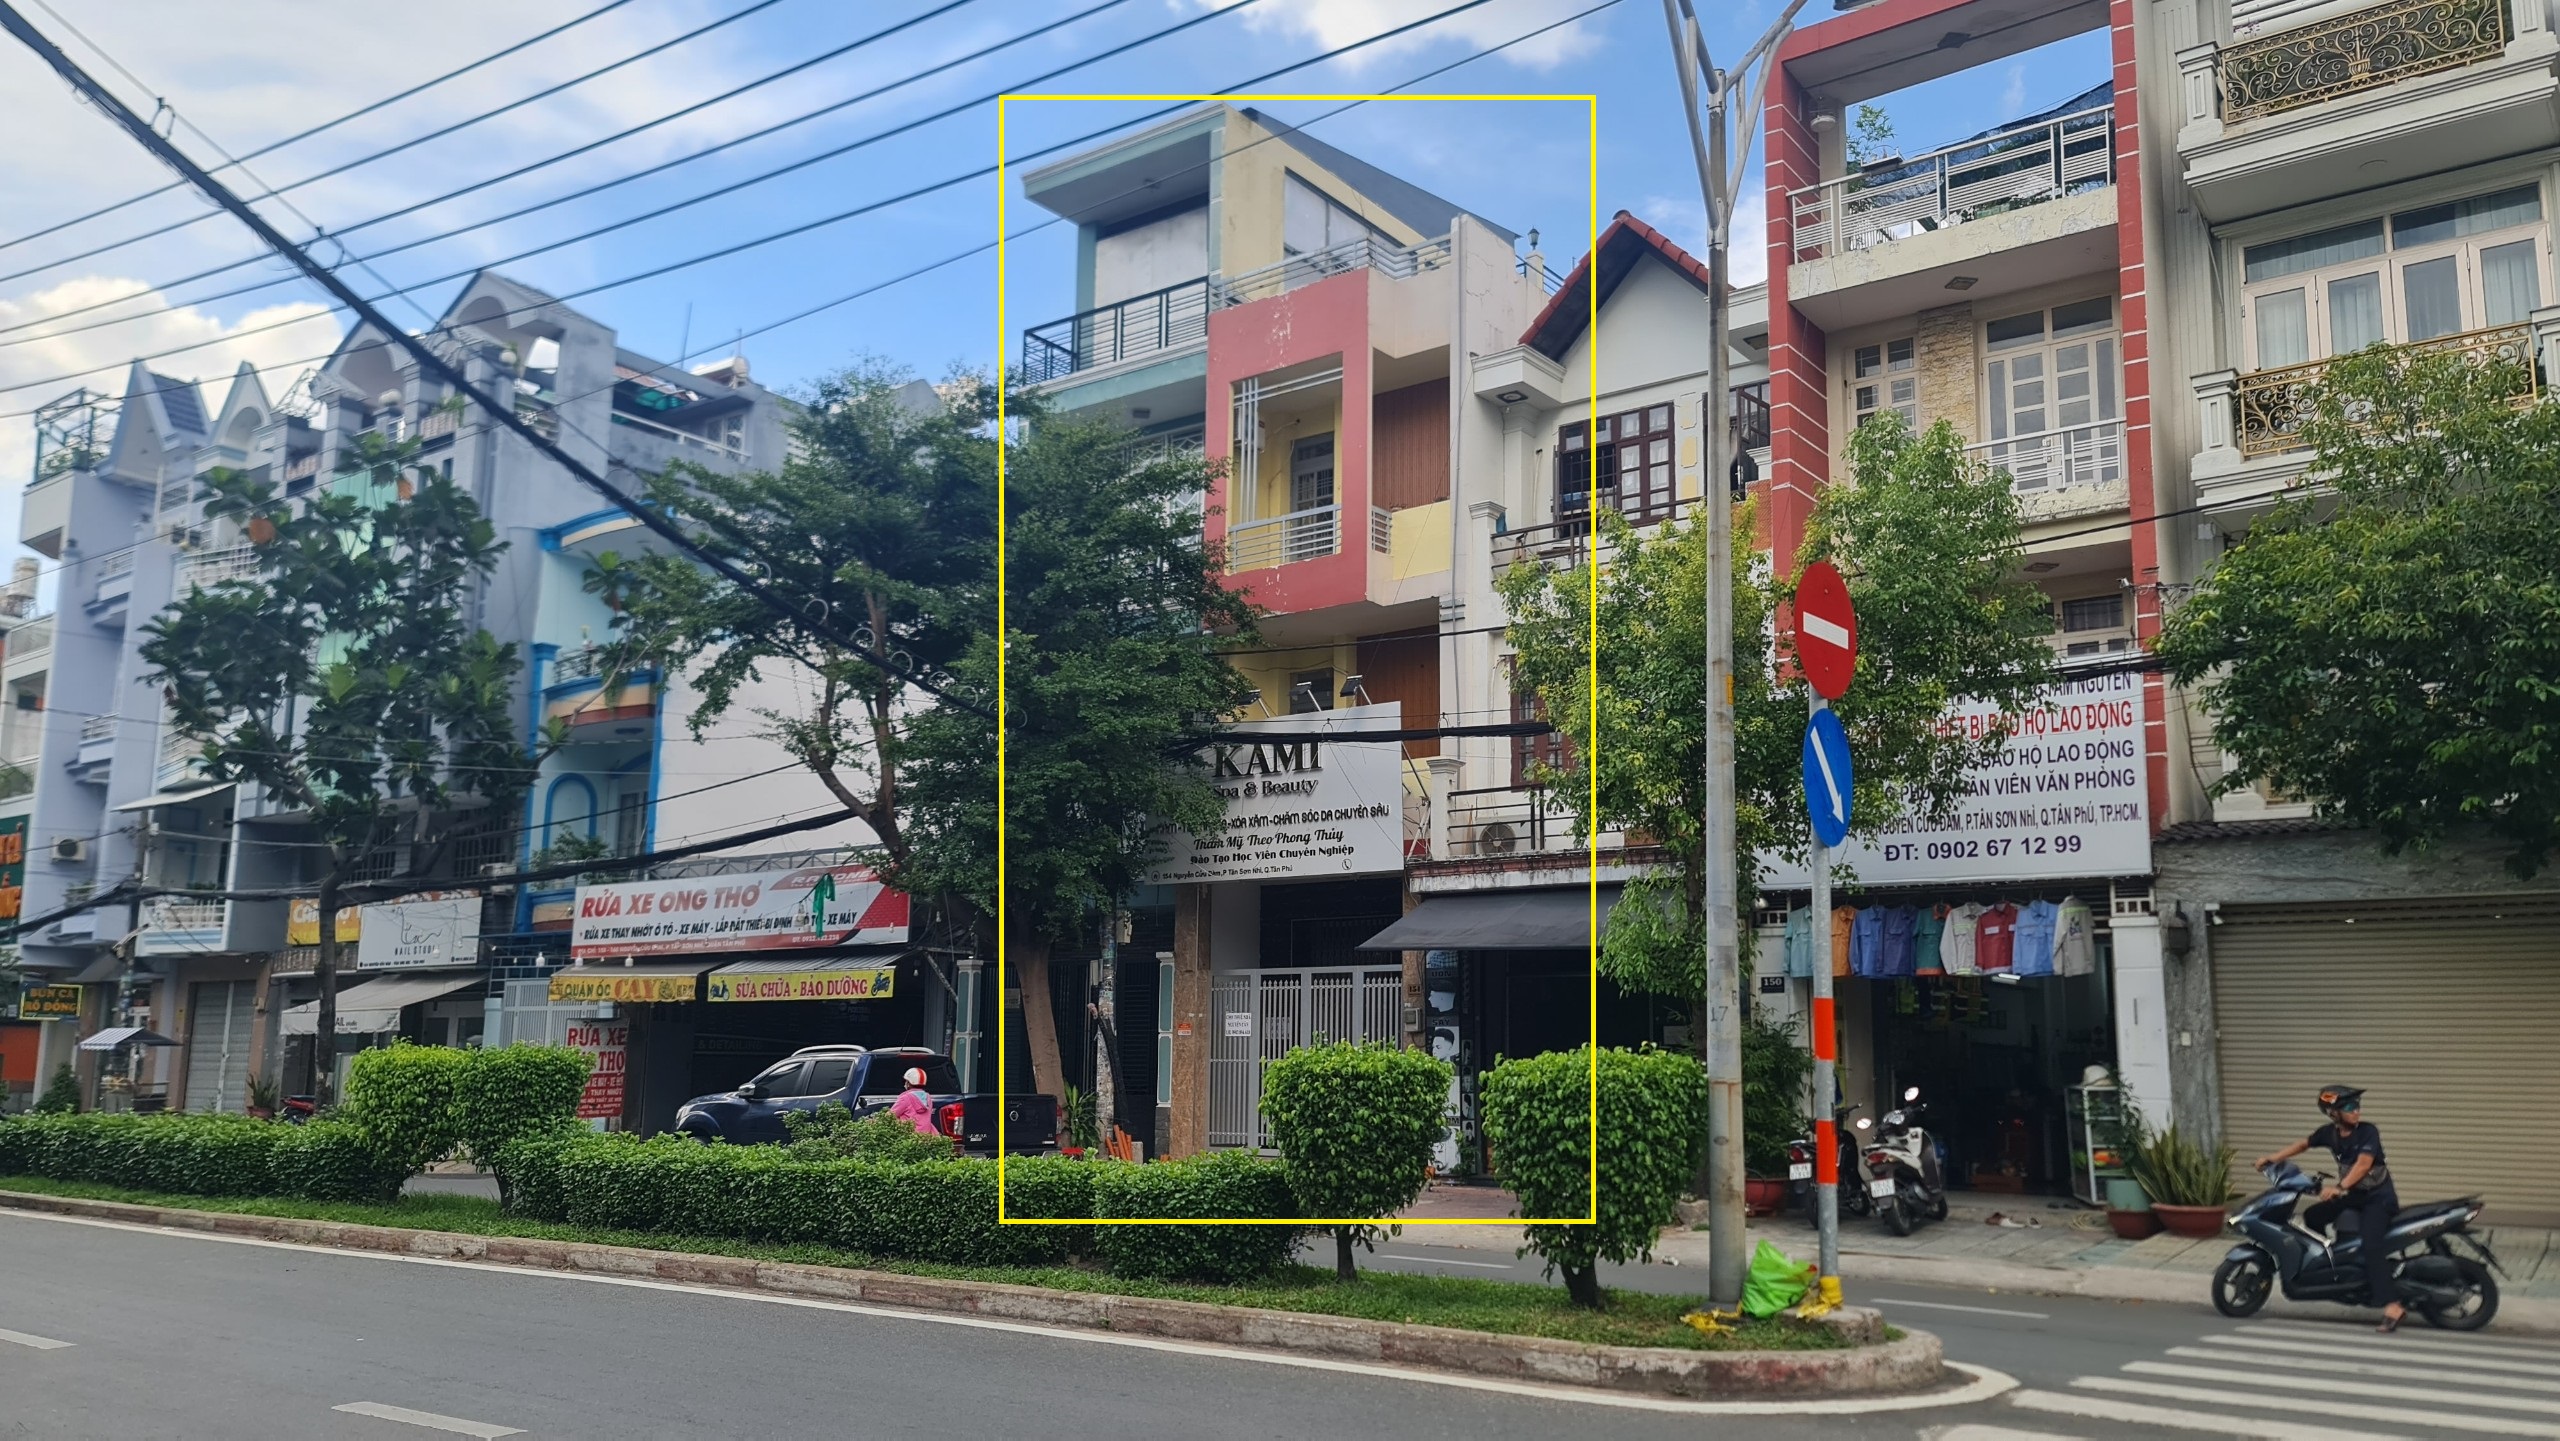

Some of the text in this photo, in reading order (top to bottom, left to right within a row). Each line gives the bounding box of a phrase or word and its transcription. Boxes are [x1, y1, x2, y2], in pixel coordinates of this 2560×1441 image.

[2025, 707, 2047, 740] HỘ
[2052, 705, 2082, 732] LAO
[2086, 699, 2133, 735] ĐỘNG
[1213, 741, 1323, 777] KAMI
[2020, 742, 2042, 765] HỘ
[2047, 744, 2081, 764] LAO
[2085, 739, 2135, 763] ĐỘNG
[1243, 782, 1257, 797] &
[1262, 779, 1319, 796] Beauty
[1994, 773, 2031, 795] VIÊN
[2035, 770, 2070, 792] VĂN
[2075, 767, 2136, 790] PHÒNG
[1302, 808, 1319, 824] SÓC
[1321, 809, 1333, 822] DA
[1335, 806, 1369, 821] CHUYÊN
[1370, 803, 1390, 818] SÂU
[1966, 811, 1993, 831] P.TÂN
[1996, 809, 2017, 829] SƠN
[2041, 806, 2072, 828] Q.TÂN
[1226, 835, 1244, 850] Mỹ
[1247, 832, 1273, 847] Theo
[1274, 831, 1311, 848] Phong
[1314, 827, 1344, 842] Thủy
[1884, 835, 2082, 861] ĐT: 0902 67 12 99
[1212, 854, 1230, 865] Tạo
[1232, 851, 1252, 863] Học
[1255, 848, 1276, 860] Viên
[1279, 847, 1316, 861] Chuyên
[1319, 844, 1354, 859] Nghiệp
[792, 870, 872, 884] RAONE
[581, 880, 763, 918] RỬA XE ONG THỢ
[584, 924, 600, 940] RỬA
[600, 926, 611, 940] XE
[611, 925, 630, 939] THAY
[631, 922, 653, 938] NHỚT
[654, 921, 662, 937] Ô
[662, 921, 675, 936] TÔ
[679, 923, 690, 935] XE
[691, 918, 710, 934] MÁY
[827, 913, 839, 926] XE
[839, 908, 858, 925] MÁY
[413, 944, 435, 955] STUDI
[565, 981, 594, 997] QUÁN
[596, 979, 612, 997] ỐC
[614, 978, 659, 1000] CAY
[735, 976, 757, 998] SỬA
[760, 977, 791, 998] CHỮA
[800, 975, 823, 997] BẢO
[826, 975, 868, 997] DƯỠNG
[1764, 978, 1782, 986] 150
[567, 1021, 627, 1046] RỬA XE
